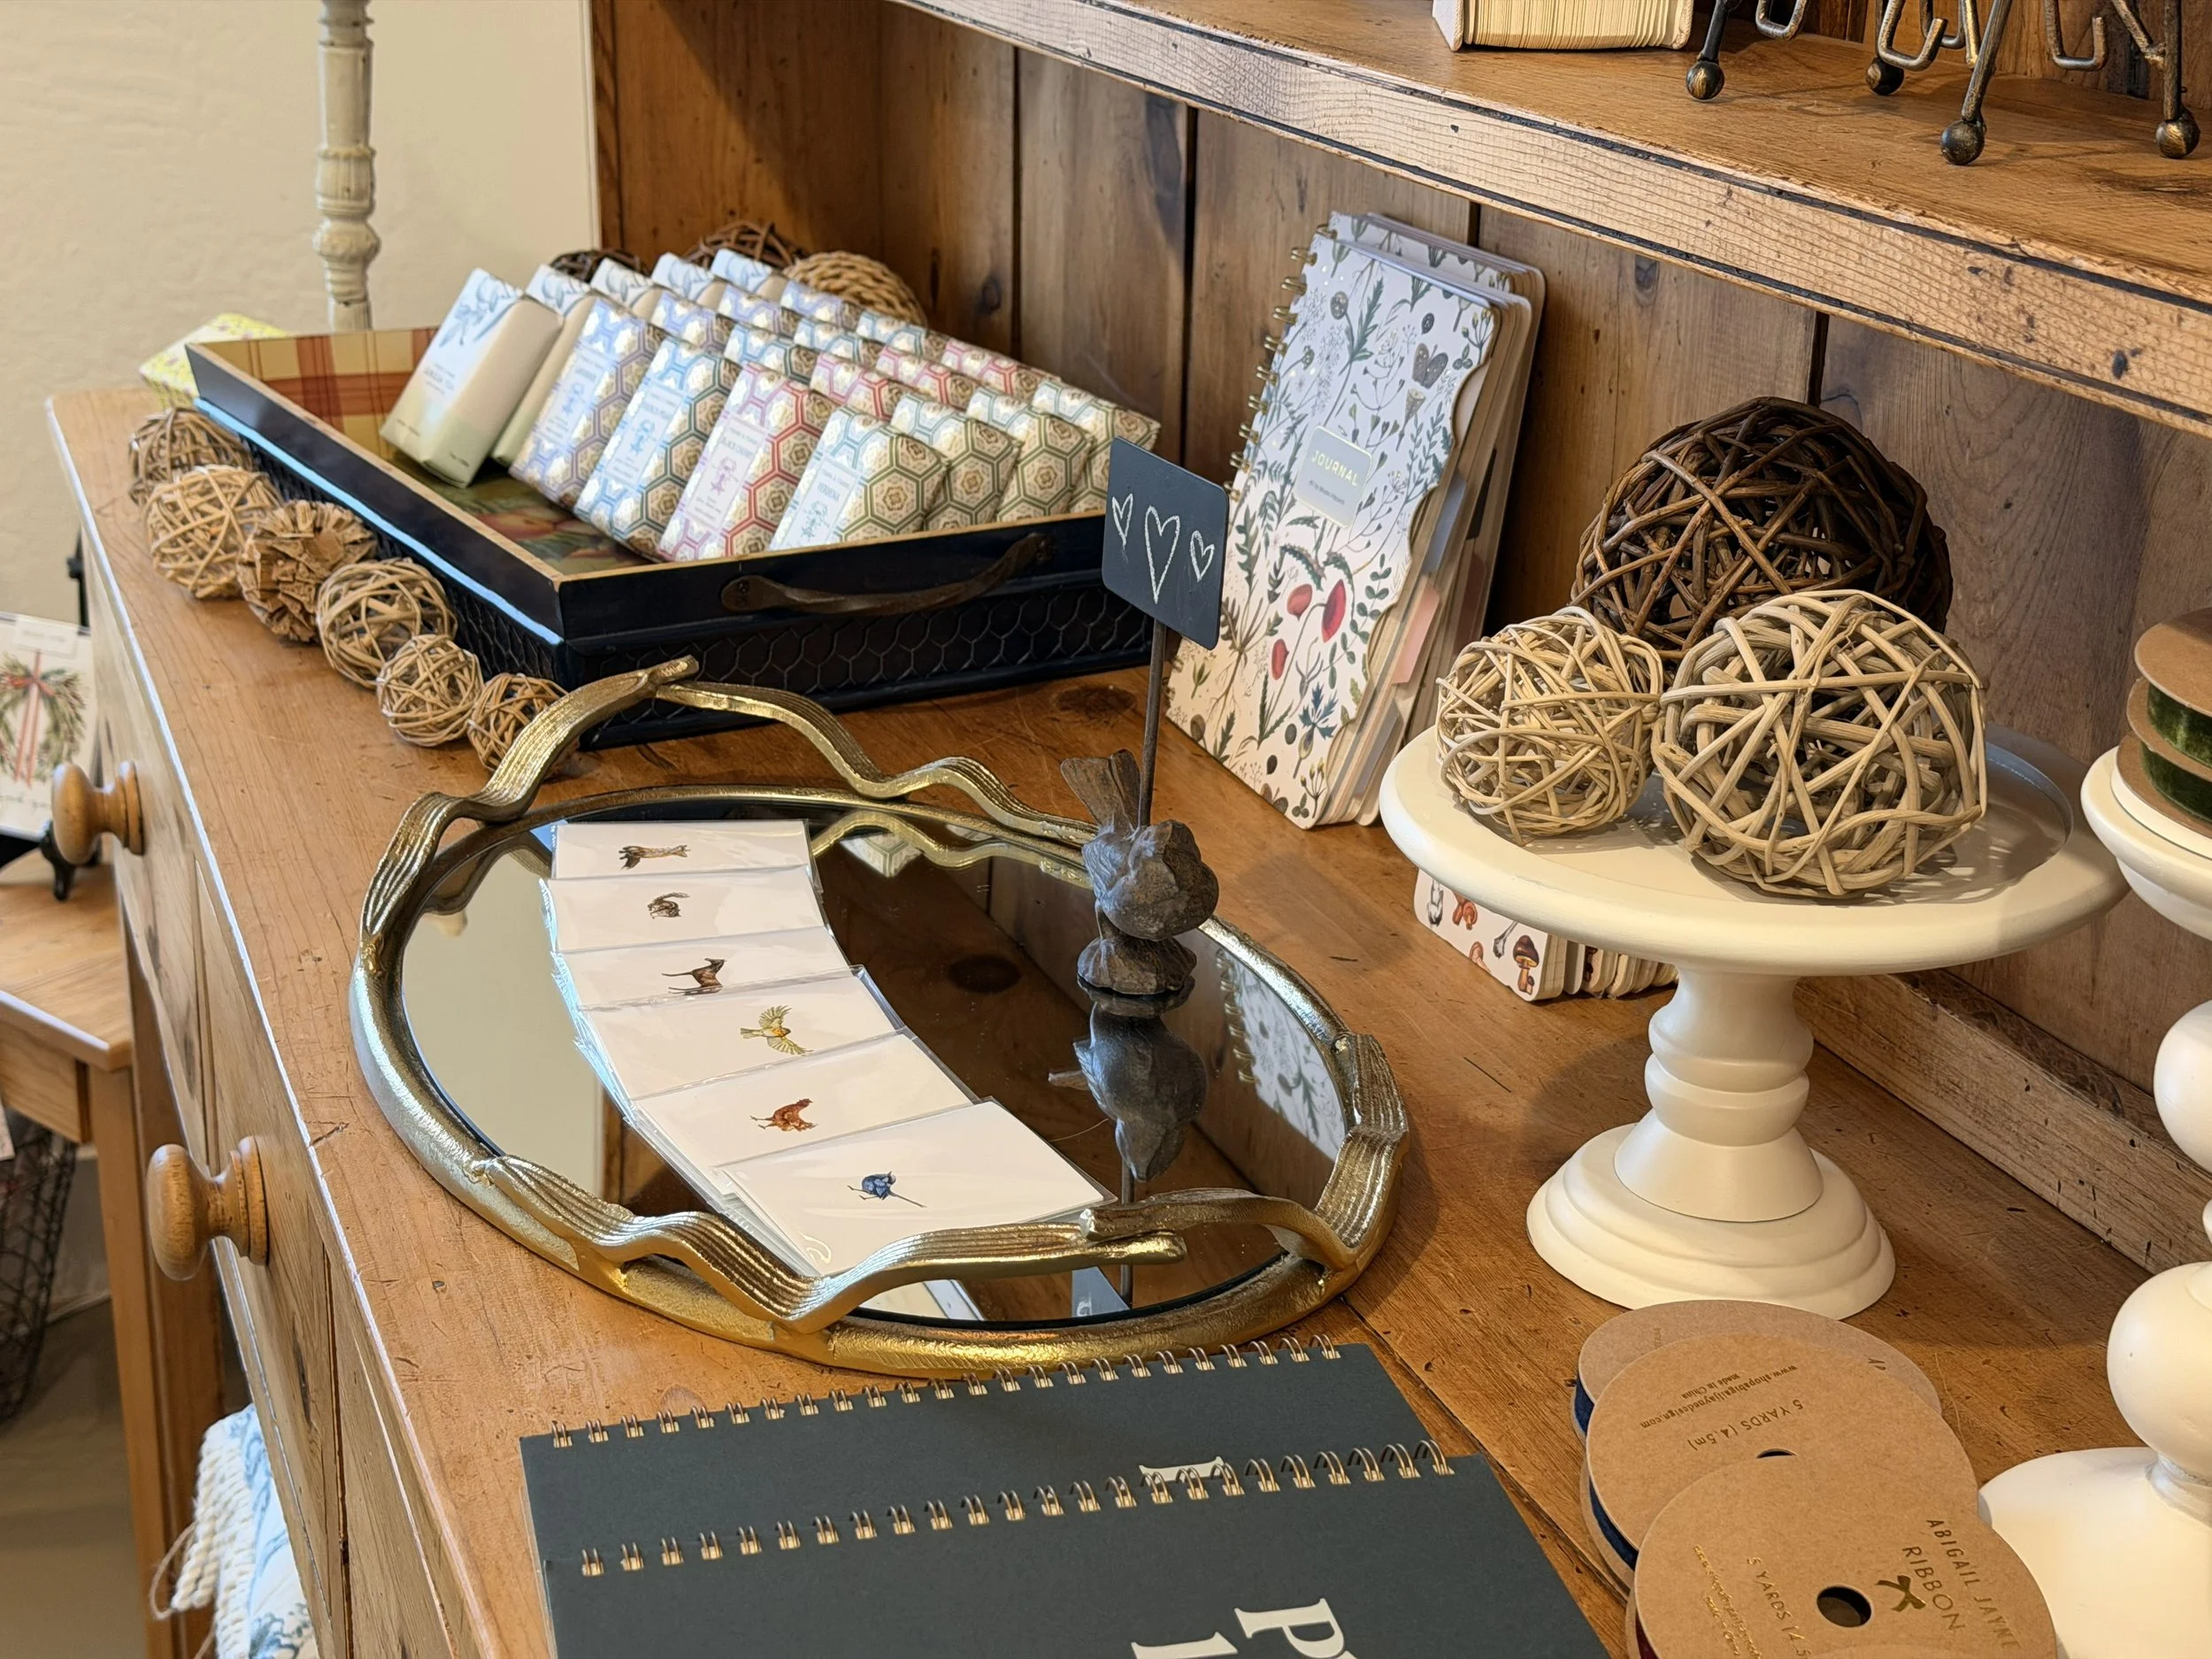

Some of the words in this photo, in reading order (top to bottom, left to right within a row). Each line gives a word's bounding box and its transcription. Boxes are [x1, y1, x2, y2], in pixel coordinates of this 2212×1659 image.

[1311, 450, 1357, 487] JOURNAL
[1681, 1386, 1708, 1400] China
[1706, 1380, 1717, 1390] in
[1717, 1374, 1740, 1386] made
[1640, 1364, 1798, 1429] www.shopabigailjaynedesign.com
[1792, 1399, 1804, 1410] 5
[1740, 1406, 1791, 1431] YARDS
[1686, 1424, 1739, 1451] (4.5m)
[1754, 1571, 1792, 1620] YARDS
[1901, 1546, 1966, 1631] RIBBON
[1926, 1519, 1981, 1588] ABIGAIL
[1973, 1596, 2023, 1649] JAYNE
